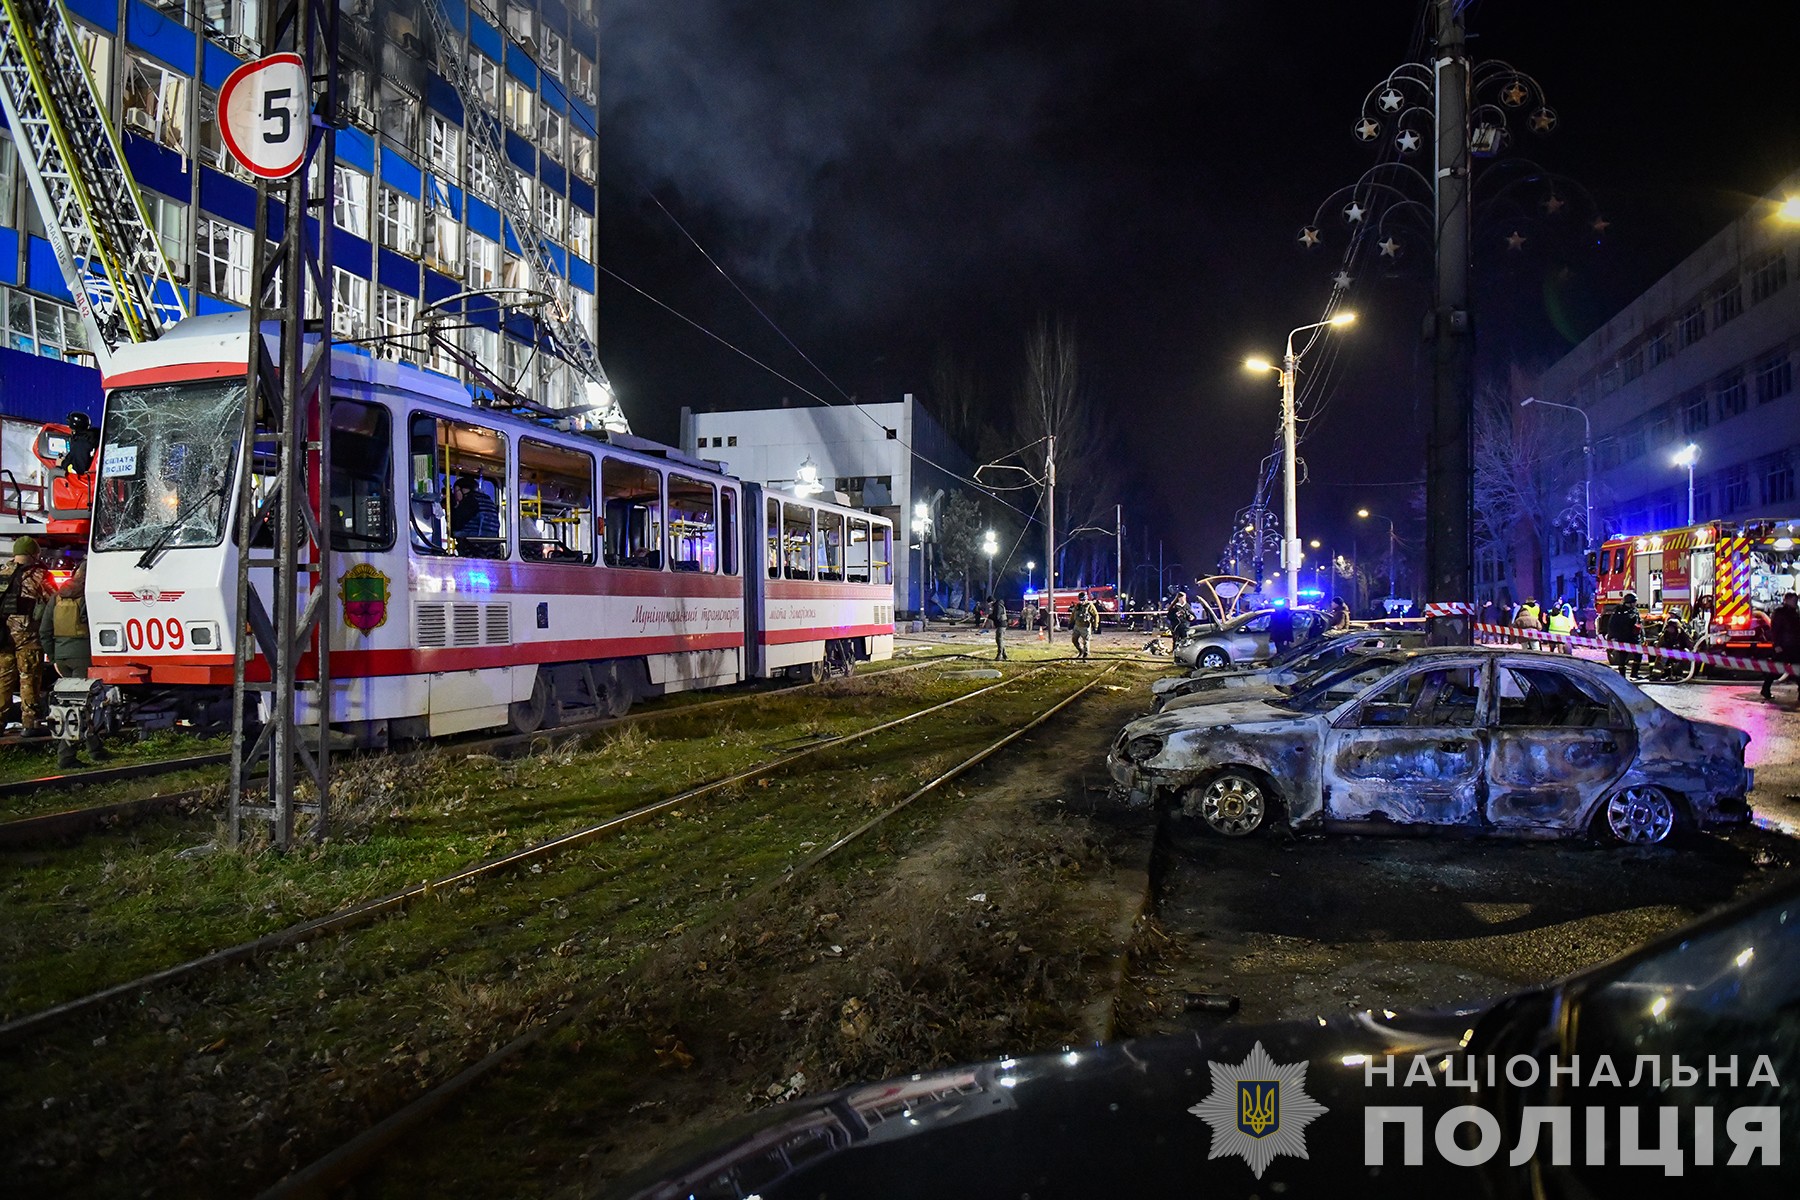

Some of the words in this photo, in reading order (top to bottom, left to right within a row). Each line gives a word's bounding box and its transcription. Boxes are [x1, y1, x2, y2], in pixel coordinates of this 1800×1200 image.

[263, 88, 292, 144] 5
[47, 222, 67, 264] MAGIRUS
[82, 306, 90, 319] 42
[126, 617, 185, 651] 009
